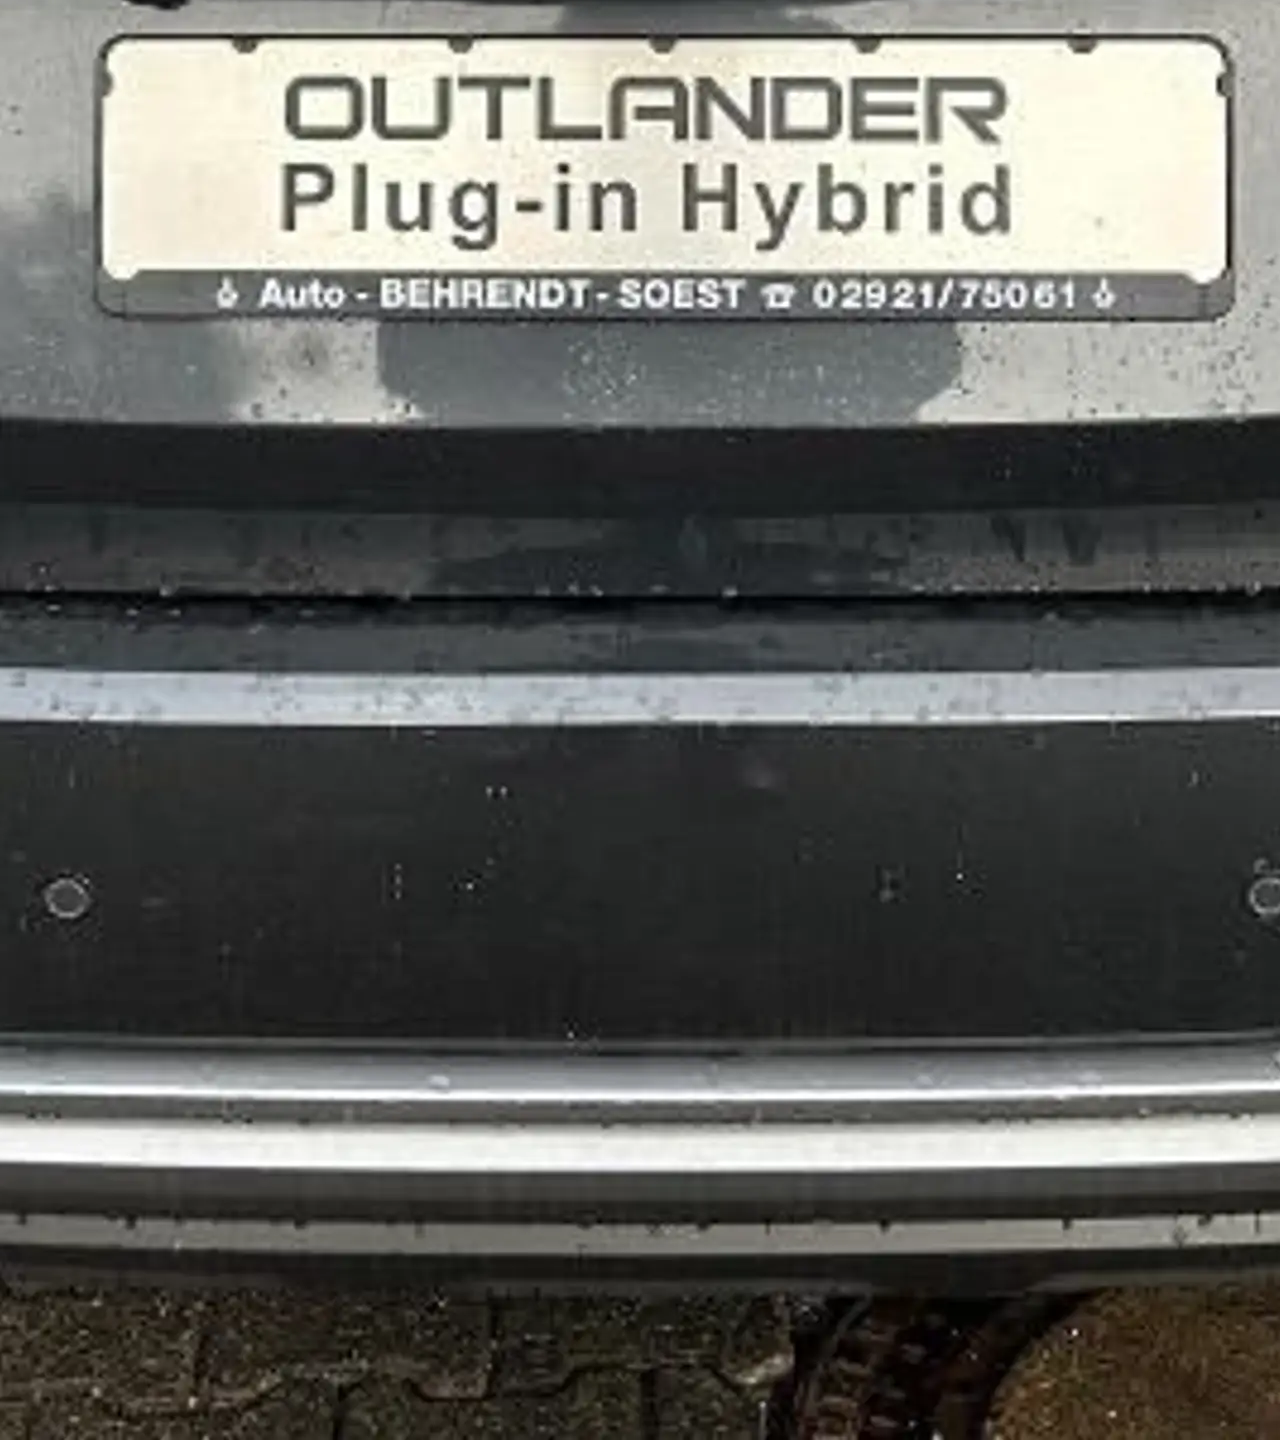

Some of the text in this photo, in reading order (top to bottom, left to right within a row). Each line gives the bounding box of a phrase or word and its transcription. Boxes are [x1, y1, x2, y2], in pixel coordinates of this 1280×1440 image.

[285, 75, 1008, 142] OUTLANDER
[282, 162, 1011, 251] Plug-in Hybrid
[259, 279, 346, 309] Auto
[379, 278, 591, 309] BEHRENDT
[618, 278, 746, 310] SOEST
